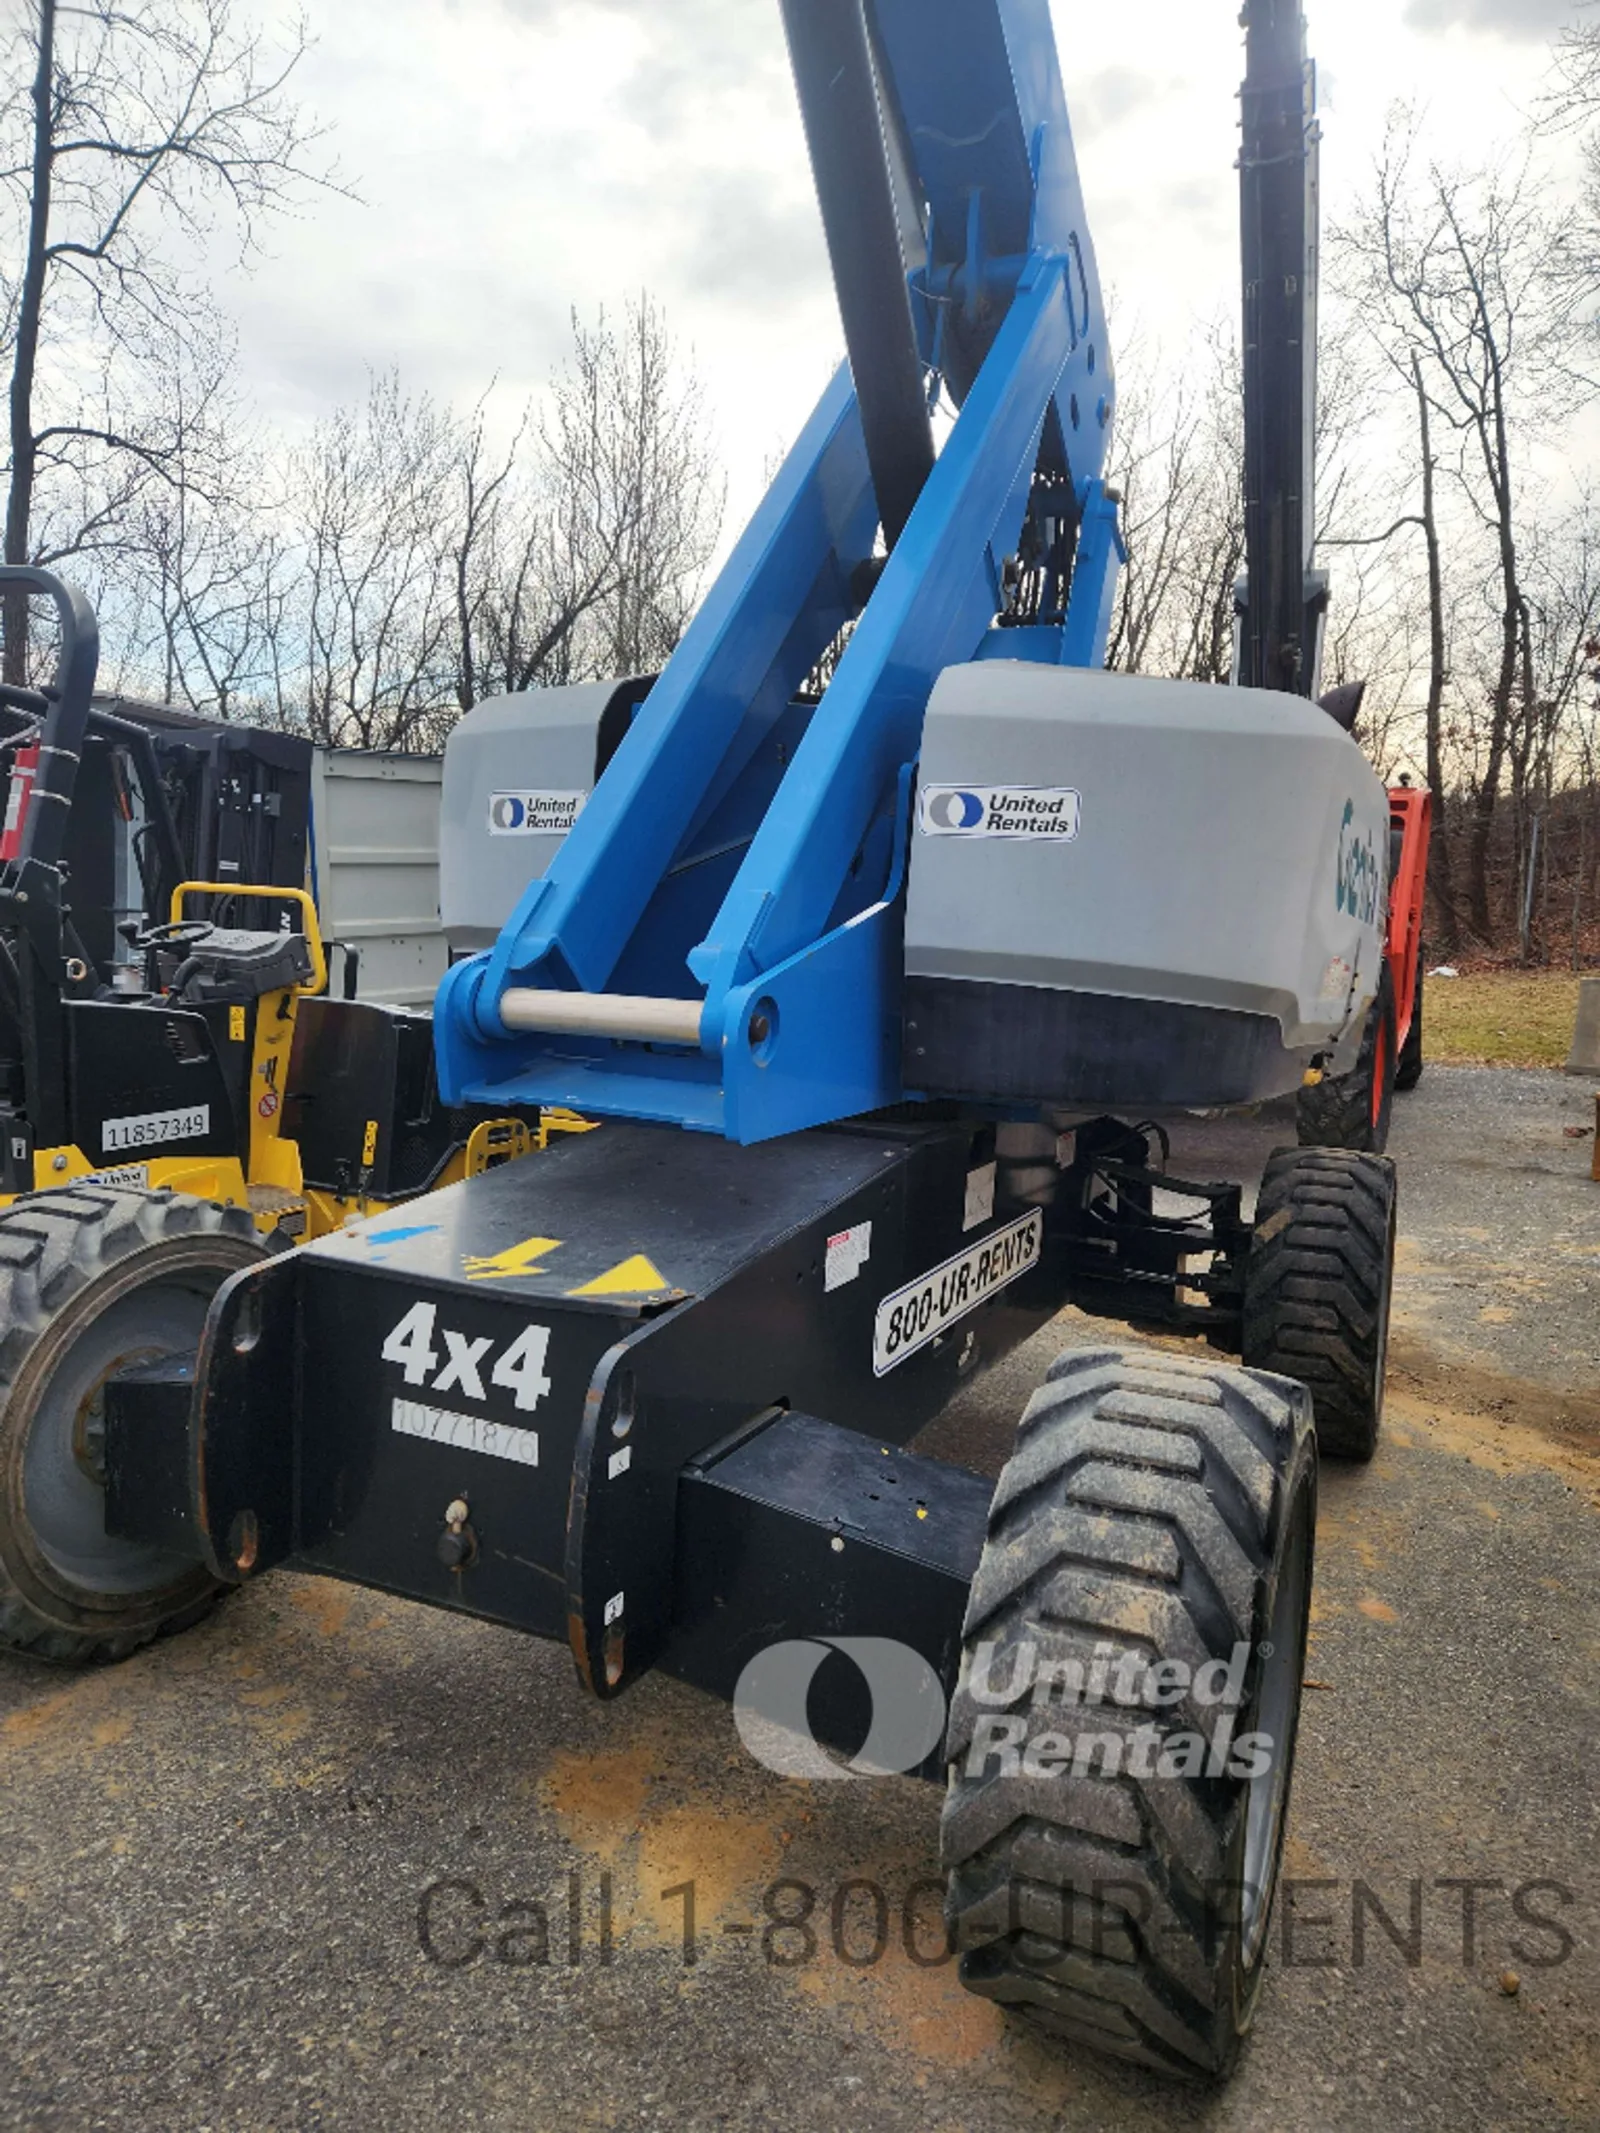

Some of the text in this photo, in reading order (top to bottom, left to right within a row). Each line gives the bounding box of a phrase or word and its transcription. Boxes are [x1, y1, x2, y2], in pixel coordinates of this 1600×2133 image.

[527, 797, 577, 812] United
[989, 793, 1064, 814] United
[986, 812, 1069, 833] Rentals
[108, 1114, 204, 1147] 11857349
[886, 1221, 1037, 1354] 800-UR-RENTS
[381, 1301, 551, 1412] 4x4
